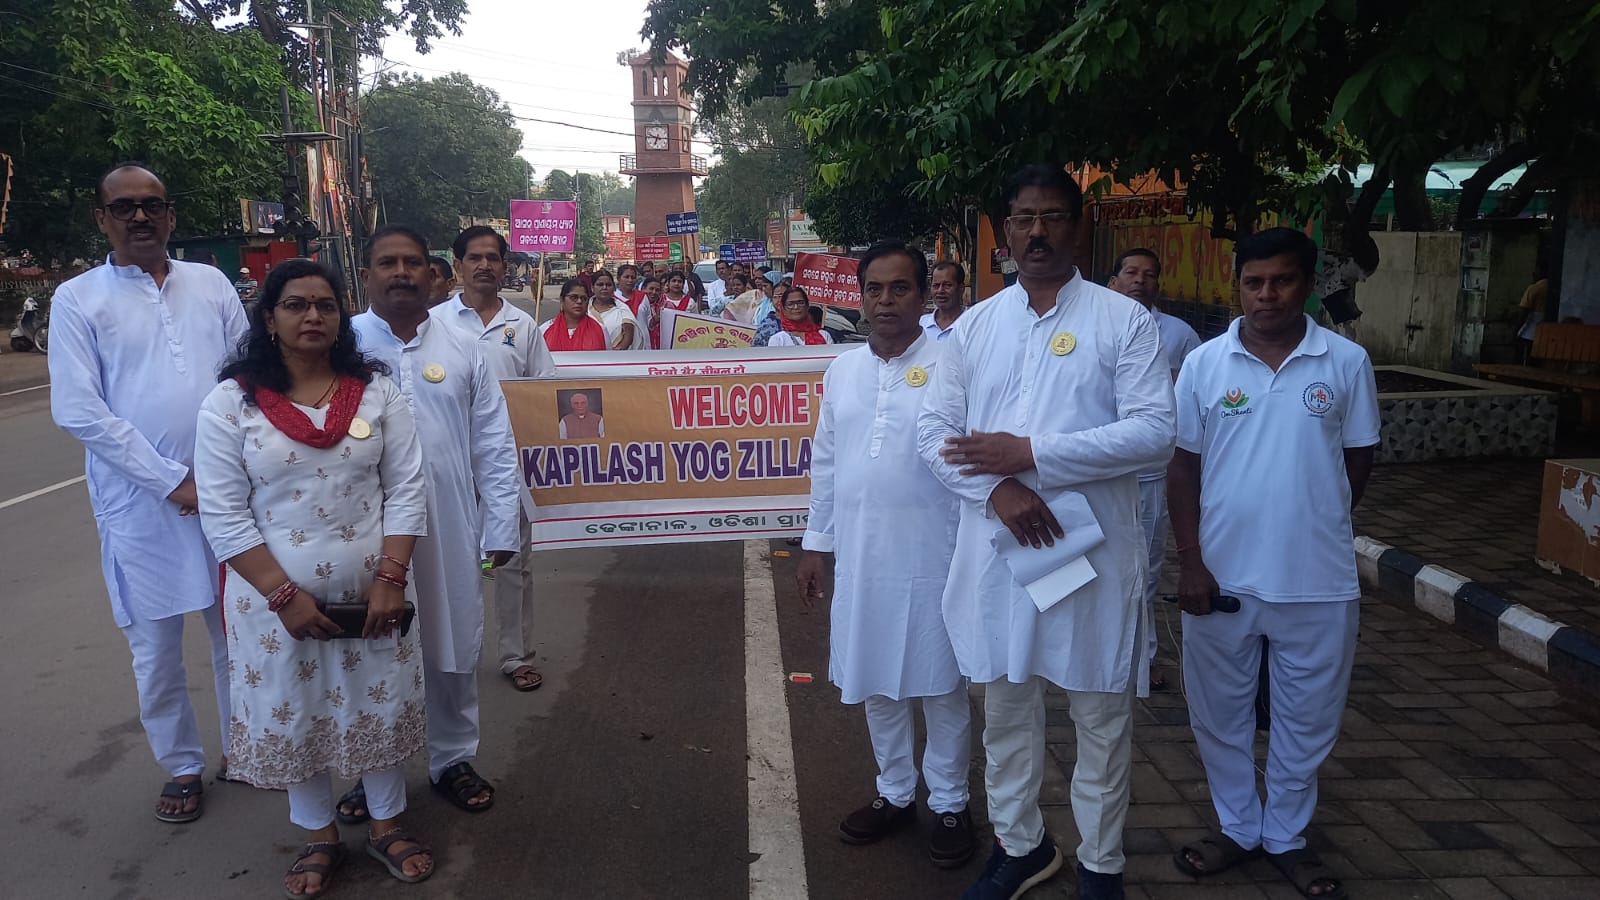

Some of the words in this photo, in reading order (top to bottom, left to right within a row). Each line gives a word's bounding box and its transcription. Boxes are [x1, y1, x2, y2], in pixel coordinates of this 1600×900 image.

[668, 383, 809, 429] WELCOME
[522, 442, 665, 488] KAPILASH
[671, 440, 730, 482] YOG
[737, 437, 812, 479] ZILLA
